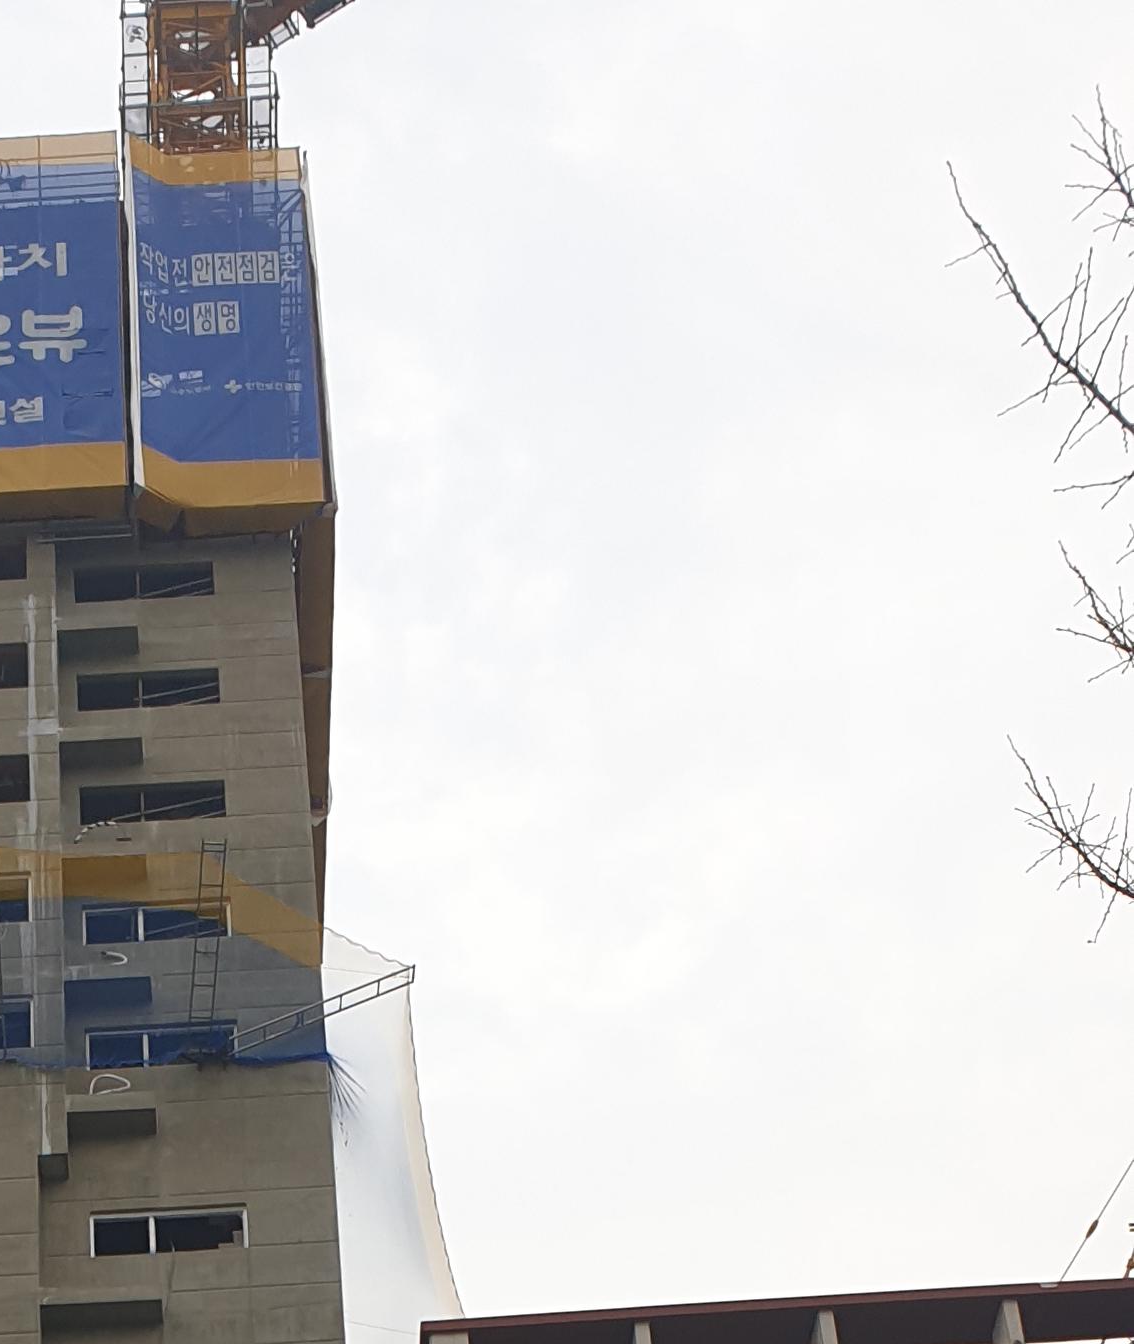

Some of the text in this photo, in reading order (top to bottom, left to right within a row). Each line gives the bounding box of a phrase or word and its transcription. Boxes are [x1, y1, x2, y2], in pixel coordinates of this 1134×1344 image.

[193, 252, 278, 286] 안전점검
[143, 289, 238, 336] 당신의 생명
